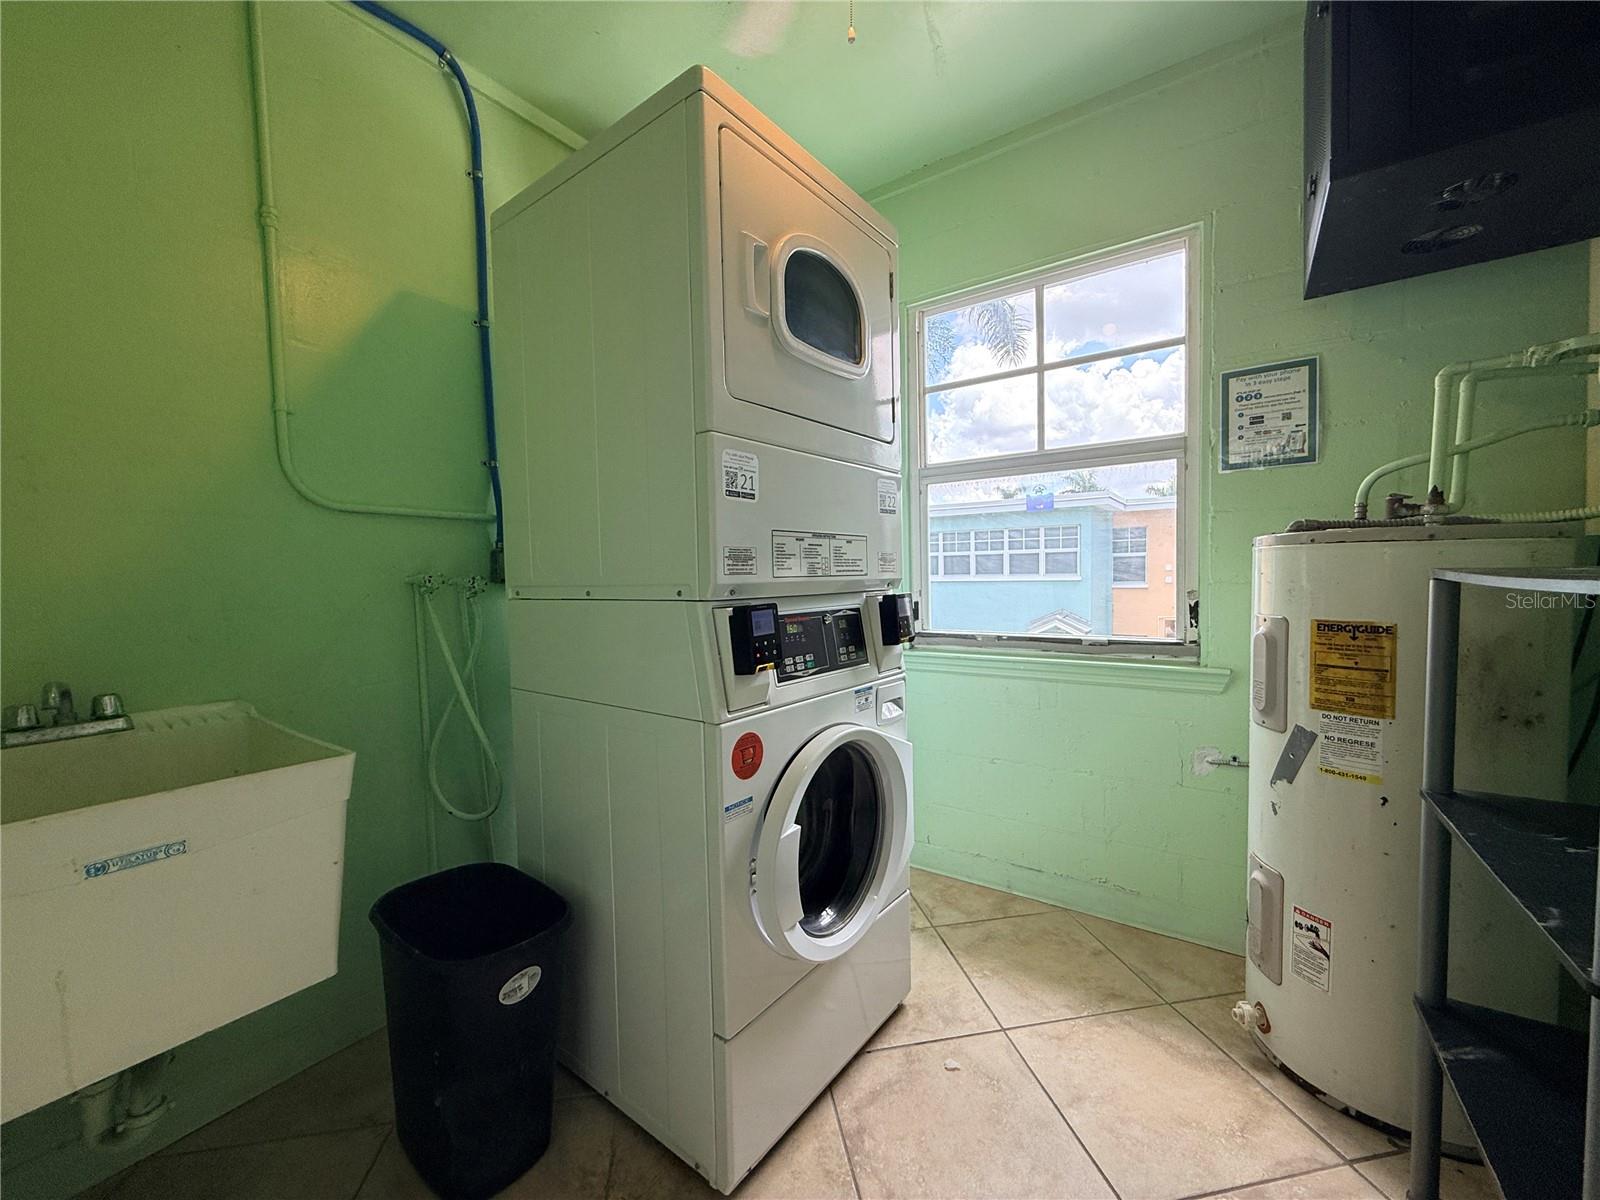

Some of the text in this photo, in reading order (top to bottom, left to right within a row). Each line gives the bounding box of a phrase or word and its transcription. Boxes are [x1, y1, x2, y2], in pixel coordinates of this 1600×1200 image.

[740, 473, 756, 491] 21
[887, 495, 896, 508] 22
[1333, 714, 1347, 722] NOT
[1349, 716, 1380, 726] RETURN
[1324, 734, 1376, 748] NO REGRESE
